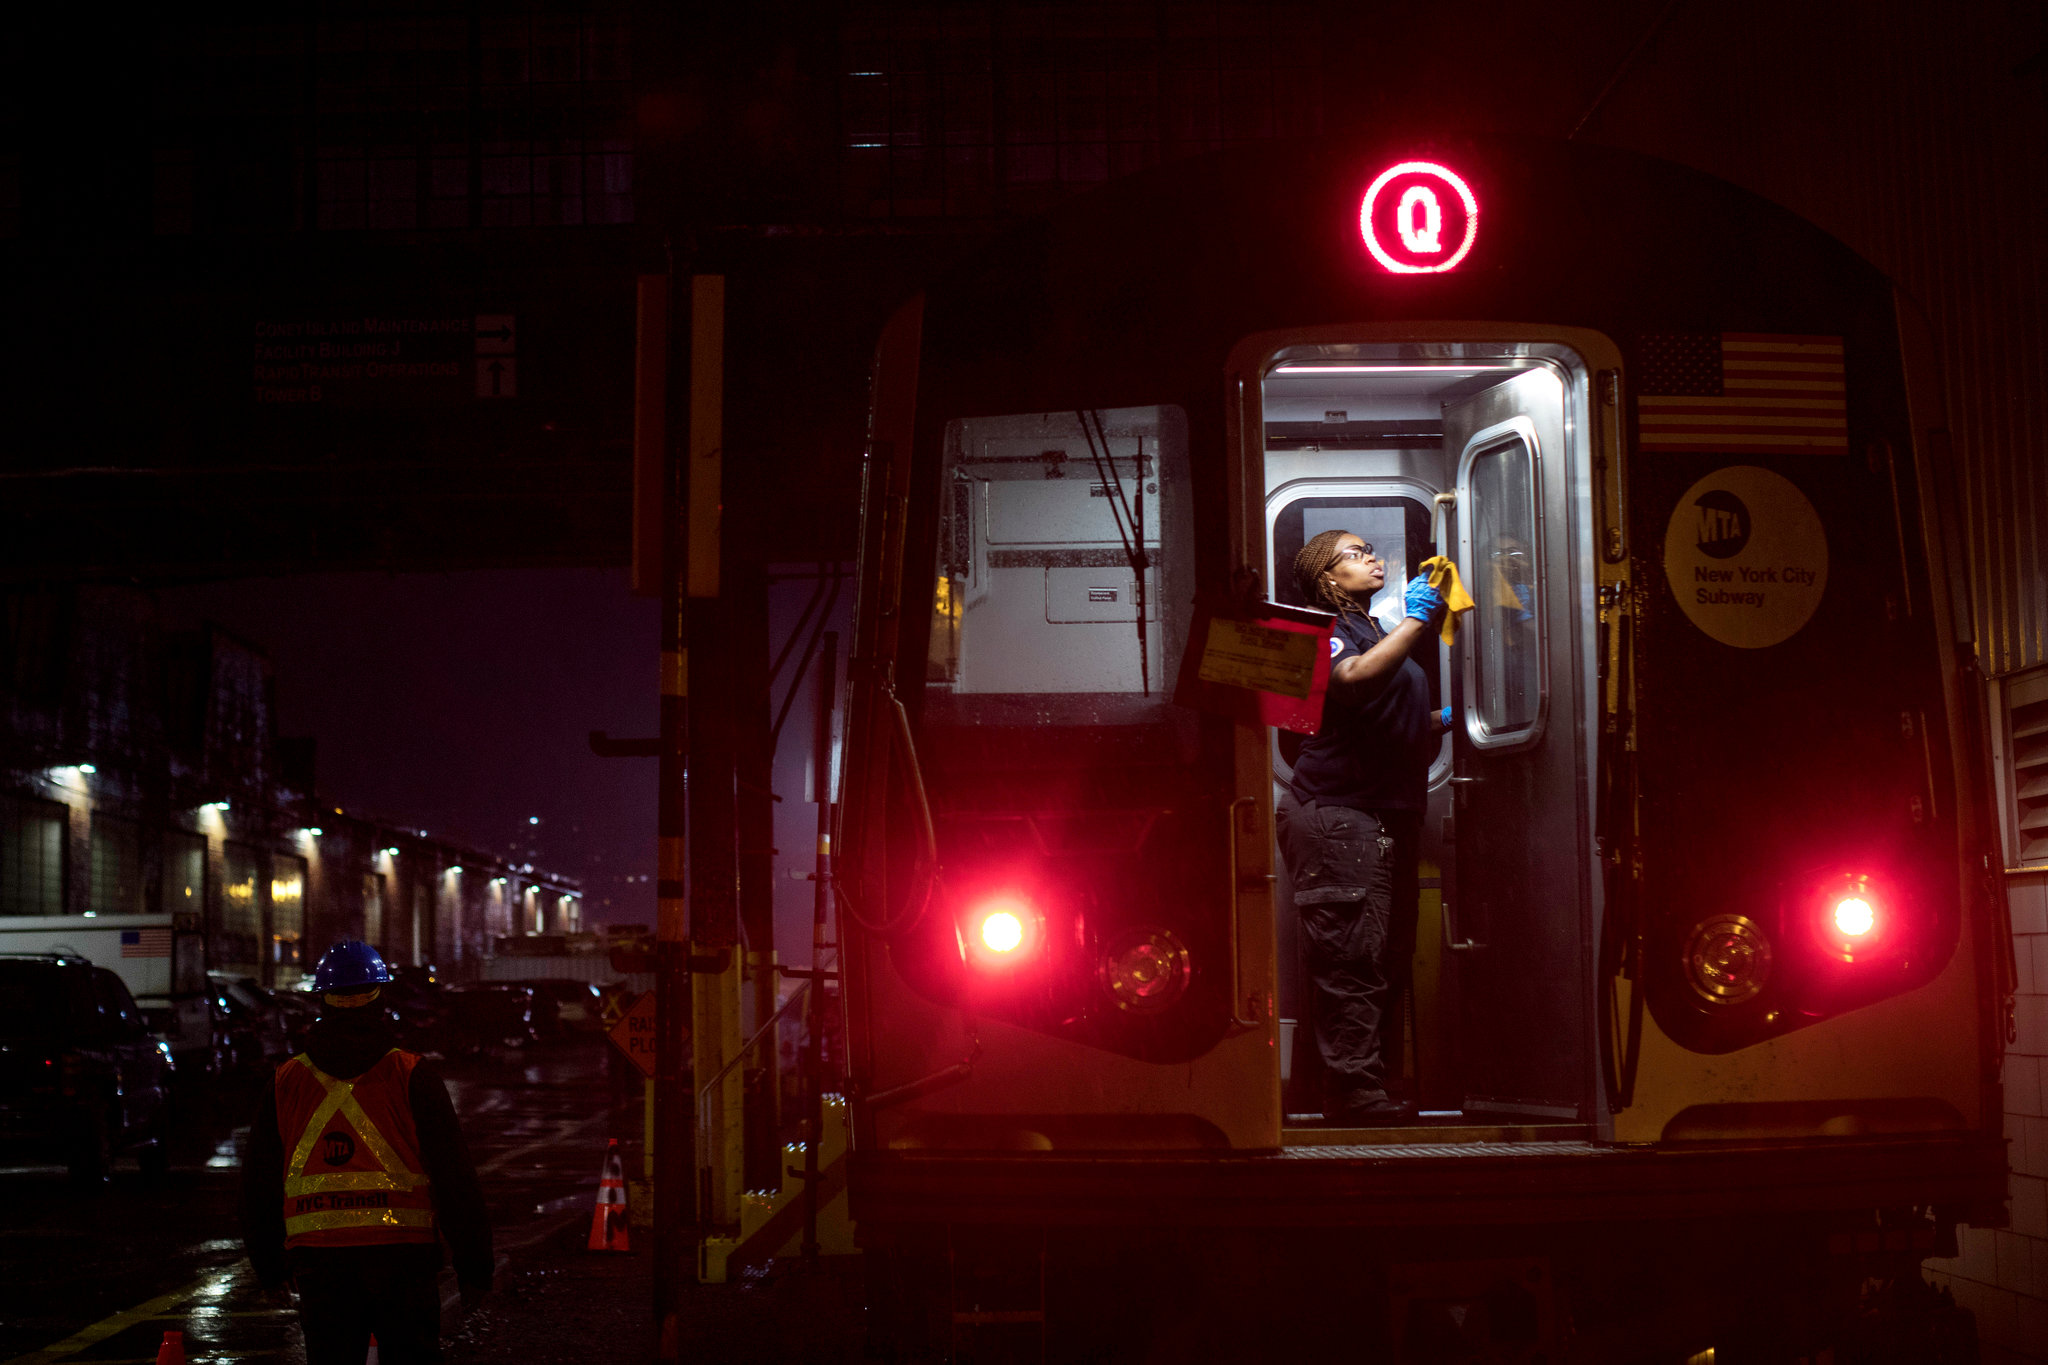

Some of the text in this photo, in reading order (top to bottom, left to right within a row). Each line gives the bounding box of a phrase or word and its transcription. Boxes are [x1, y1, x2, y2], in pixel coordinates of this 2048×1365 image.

[1397, 186, 1441, 253] Q
[1695, 502, 1744, 546] MTA
[1695, 566, 1816, 587] New York City
[1696, 588, 1765, 608] Subway
[629, 1016, 657, 1032] RAI
[629, 1037, 657, 1053] PLO
[322, 1138, 351, 1161] MTA
[296, 1192, 388, 1213] NYC Transit
